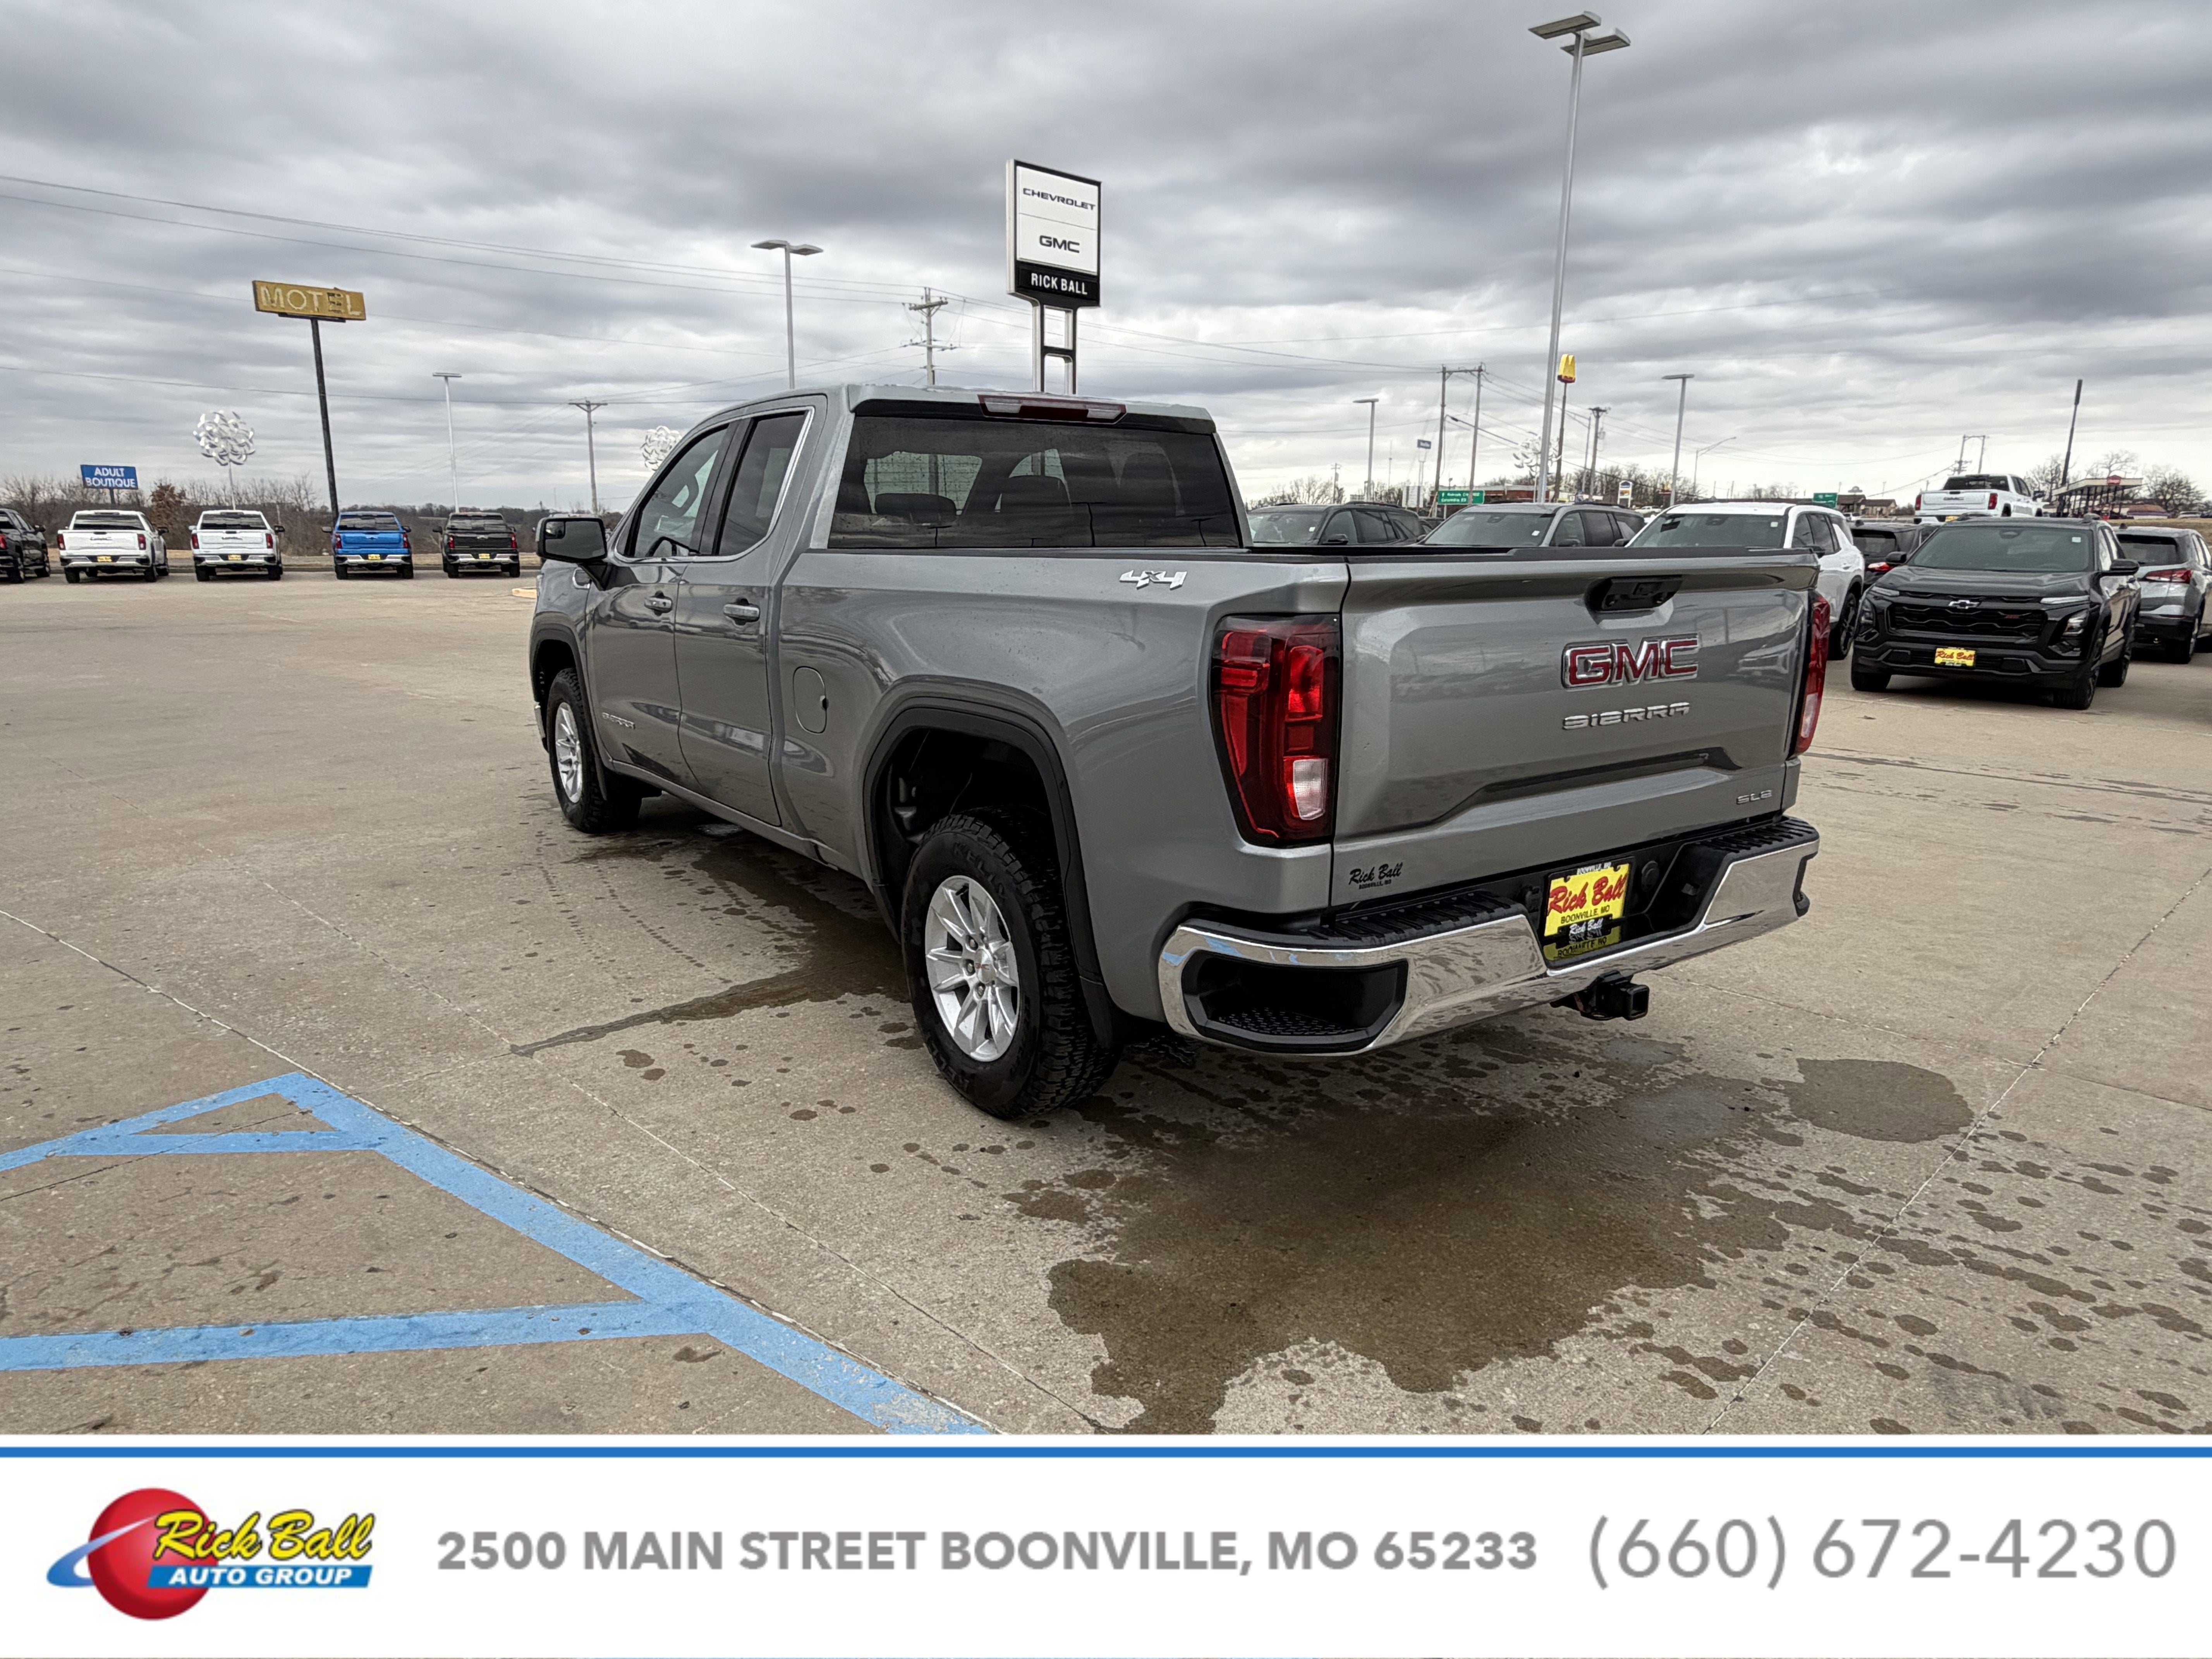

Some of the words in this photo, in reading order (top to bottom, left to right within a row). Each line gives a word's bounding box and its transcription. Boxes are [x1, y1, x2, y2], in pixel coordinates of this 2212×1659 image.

[1022, 187, 1096, 211] CHEVROLET
[1039, 235, 1080, 254] GMC
[1031, 273, 1058, 290] RICK
[1061, 278, 1087, 295] BALL
[260, 286, 361, 316] MOTEL
[85, 477, 136, 488] BOUTIQUE
[94, 467, 124, 477] ADULT
[1561, 632, 1700, 691] GMC
[1562, 702, 1690, 730] SIERRA
[1348, 866, 1375, 885] Rick
[1378, 862, 1403, 880] Ball
[1547, 881, 1589, 916] Rick
[1592, 873, 1628, 906] Ball
[1601, 905, 1610, 914] MO
